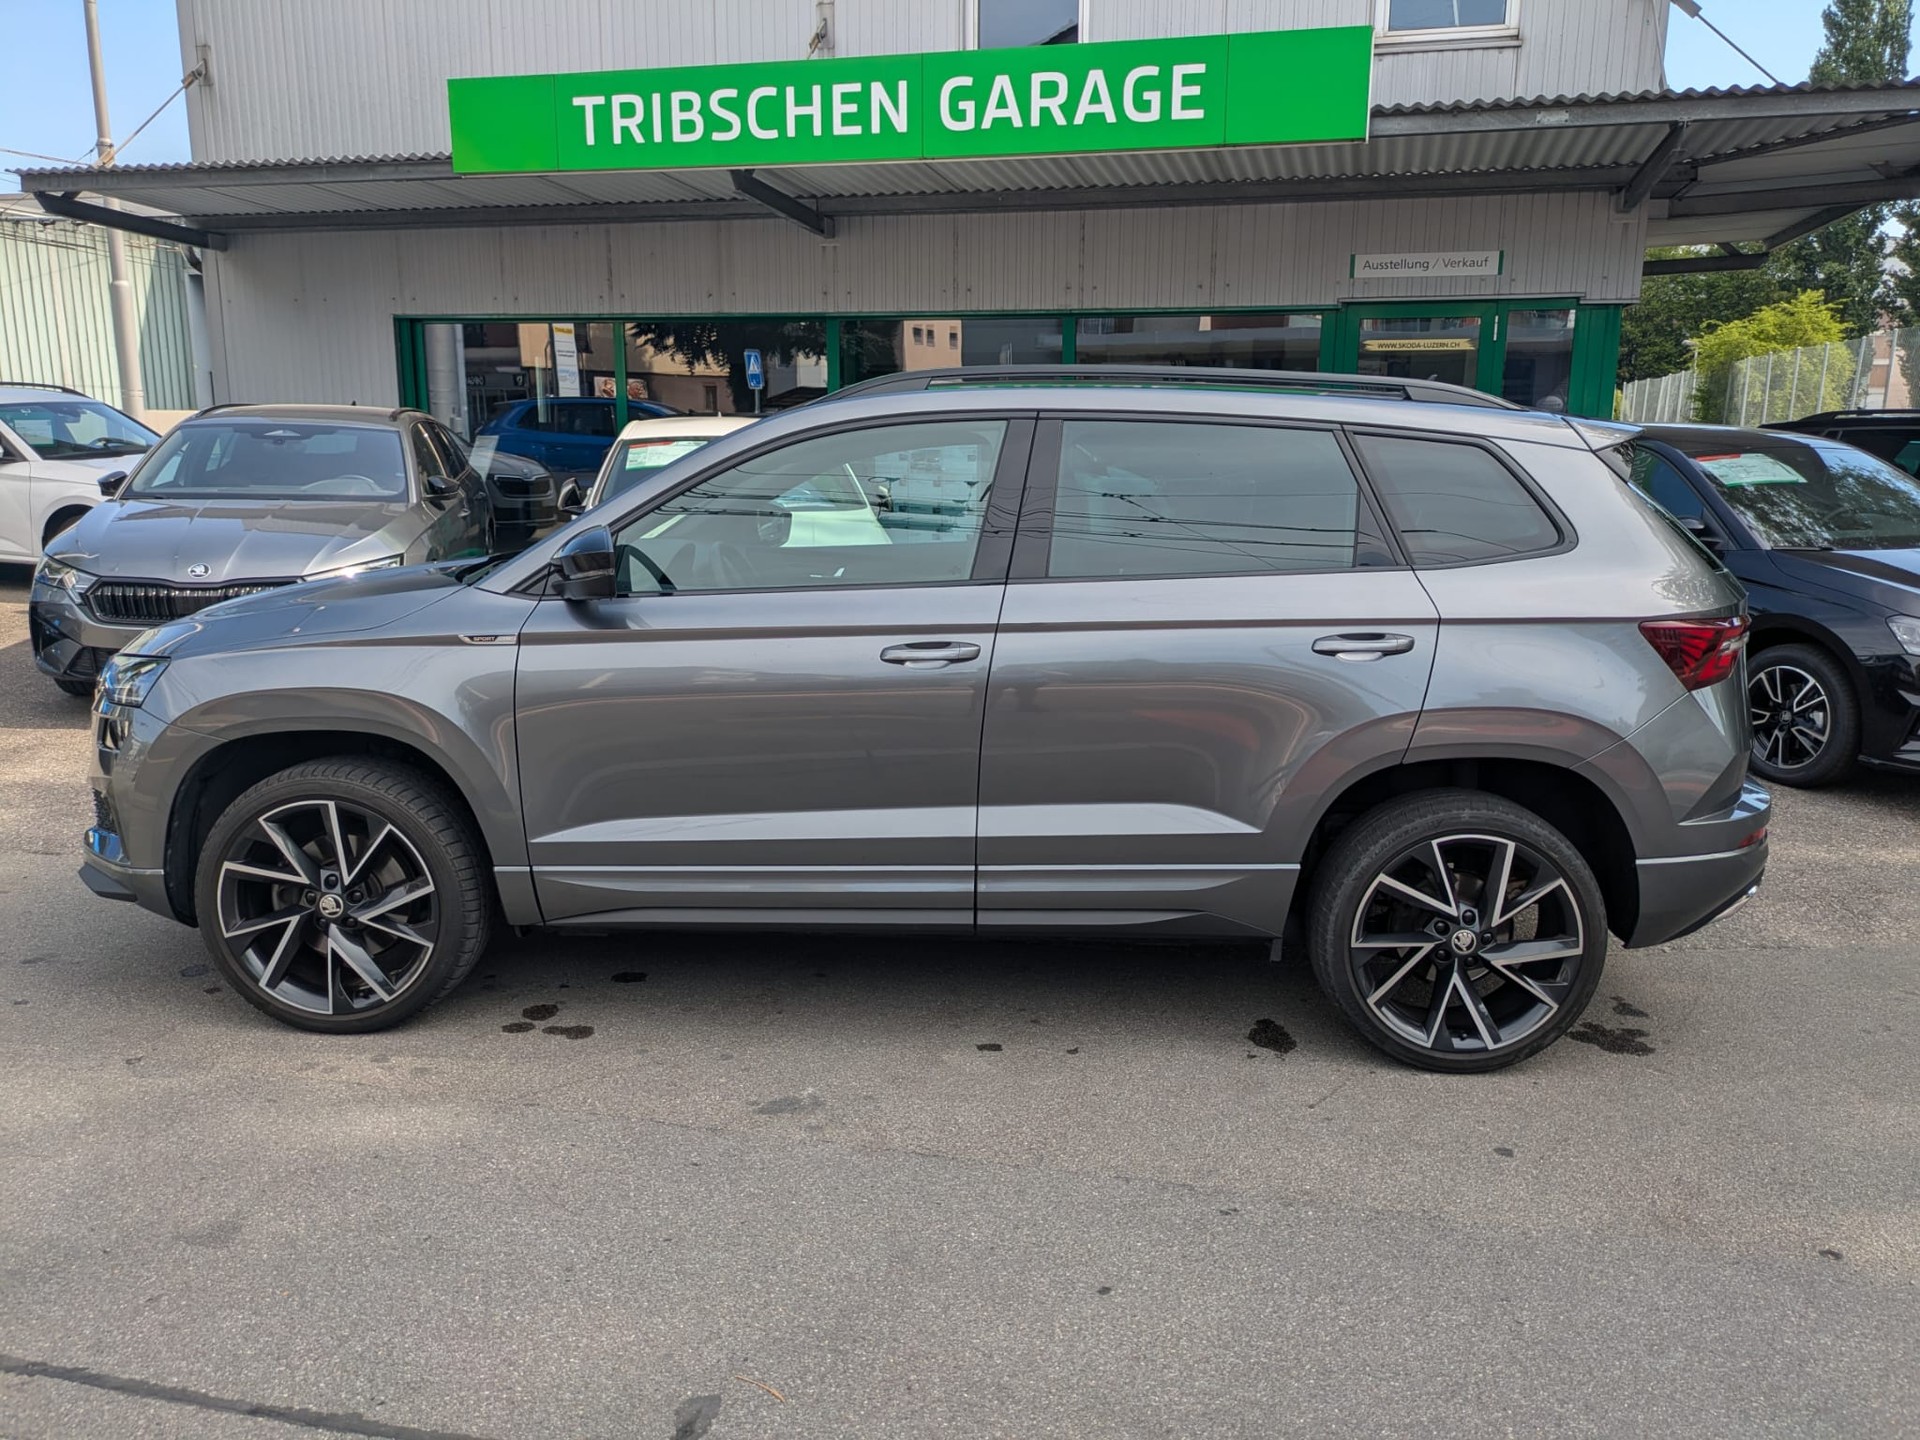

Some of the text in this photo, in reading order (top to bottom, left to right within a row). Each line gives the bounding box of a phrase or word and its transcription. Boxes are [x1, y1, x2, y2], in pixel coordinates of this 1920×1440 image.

[573, 63, 1207, 146] TRIBSCHEN GARAGE
[1363, 259, 1430, 271] Ausstellung
[1442, 257, 1489, 268] Verkauf
[1377, 341, 1460, 349] WWW.SKODA-LUZERN.CH
